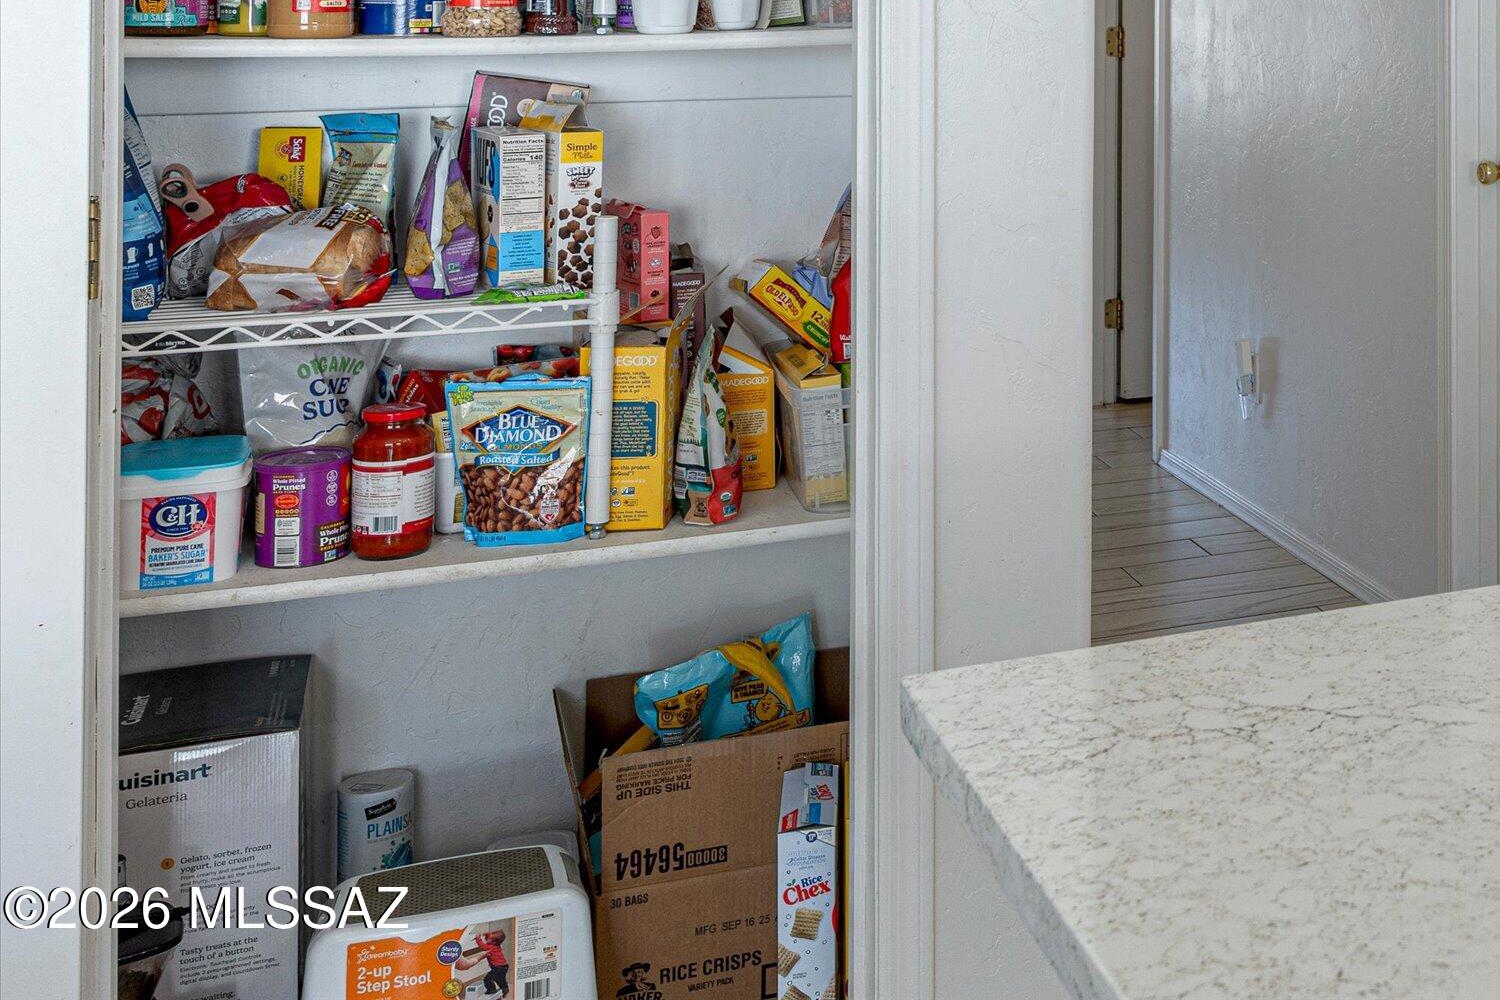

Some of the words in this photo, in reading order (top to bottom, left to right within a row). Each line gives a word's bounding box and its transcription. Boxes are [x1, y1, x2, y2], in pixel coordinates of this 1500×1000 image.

[290, 138, 303, 160] Schär
[566, 143, 598, 154] Simple
[572, 151, 593, 159] Mills
[566, 166, 595, 177] SWEET
[810, 310, 823, 324] 12
[806, 323, 829, 346] CRUNCHY
[721, 376, 769, 387] MADEGOOD
[499, 413, 540, 430] BLUE
[475, 425, 562, 443] DIAMOND
[480, 456, 519, 464] Roasted
[521, 454, 553, 463] Salted
[155, 503, 200, 527] C&H
[320, 528, 339, 537] Whole
[148, 553, 179, 563] BAKER'S
[180, 551, 206, 560] SUGAR
[740, 690, 765, 699] CHANCE
[749, 683, 765, 691] PEAS
[119, 763, 212, 791] uisinart
[616, 779, 651, 791] MARKING
[653, 775, 675, 785] PRICE
[635, 785, 662, 797] SIDE
[665, 780, 691, 793] THIS
[125, 792, 188, 810] Gelateria
[616, 789, 633, 801] UP
[367, 815, 403, 839] PLAIN
[180, 854, 211, 865] Gelato,
[212, 849, 243, 859] sorbet,
[244, 843, 272, 853] frozen
[614, 842, 684, 881] 56464
[687, 846, 726, 866] 30000
[180, 863, 212, 875] yogurt,
[227, 855, 255, 865] cream
[246, 866, 281, 875] scrumptious
[196, 871, 217, 879] creamy
[801, 875, 823, 887] Rice
[783, 880, 831, 905] Chex
[610, 898, 622, 909] 30
[625, 893, 649, 907] BAGS
[695, 923, 717, 936] MFG
[722, 919, 741, 931] SEP
[745, 917, 755, 927] 16
[759, 915, 770, 924] 25
[180, 946, 203, 957] Tasty
[206, 940, 231, 951] treats
[233, 938, 241, 946] at
[244, 936, 258, 944] the
[366, 948, 408, 960] dreambaby
[180, 956, 205, 965] touch
[206, 951, 216, 960] of
[225, 946, 255, 956] button
[180, 963, 207, 972] Electronic
[209, 958, 239, 967] Touchpad
[239, 953, 261, 962] Controls
[180, 971, 200, 979] include
[206, 962, 251, 975] preprogrammed
[252, 957, 276, 965] settings,
[357, 966, 392, 979] 2-up
[660, 962, 698, 984] RICE
[702, 950, 762, 976] CRISPS
[180, 977, 197, 985] digital
[198, 974, 219, 983] display,
[232, 966, 264, 975] countdown
[357, 980, 391, 995] Step
[393, 970, 432, 989] Stool
[687, 980, 715, 992] VARIETY
[716, 977, 734, 987] PACK
